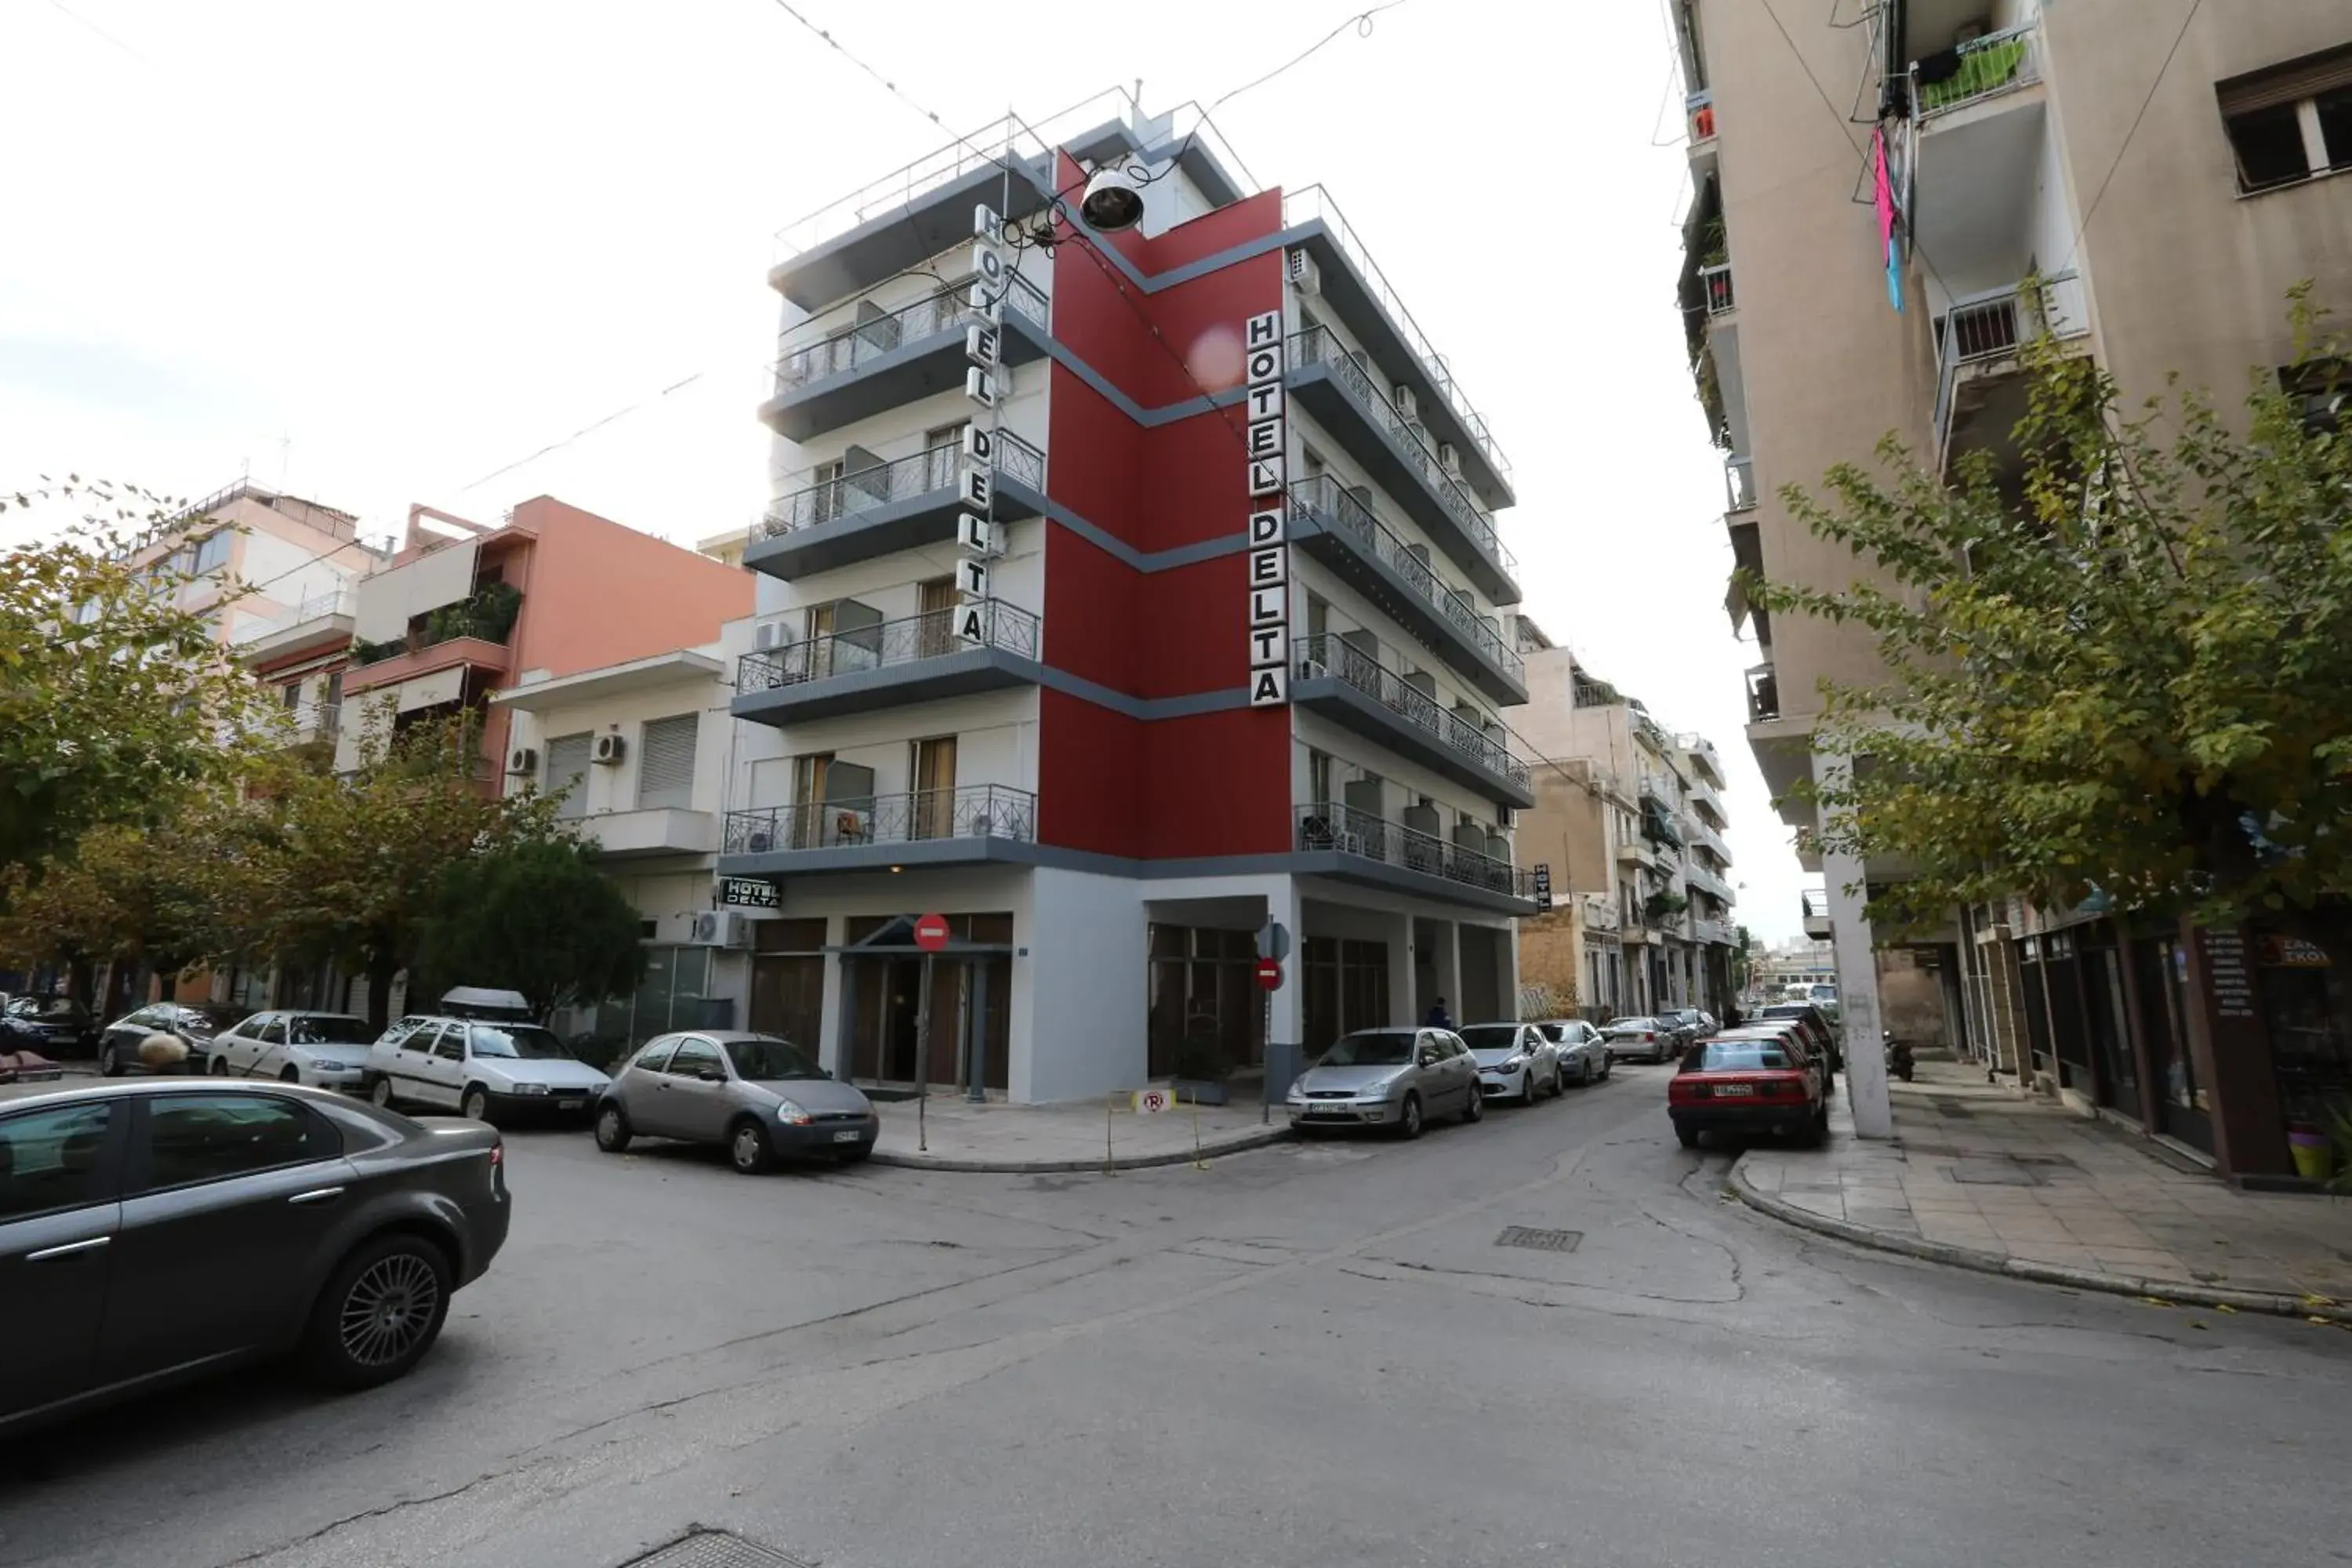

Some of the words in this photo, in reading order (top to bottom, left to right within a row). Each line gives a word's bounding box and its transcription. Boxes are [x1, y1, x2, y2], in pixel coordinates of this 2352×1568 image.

[978, 207, 1001, 403] HOTEL
[1250, 315, 1276, 491] HOTEL
[963, 427, 990, 641] DELTA
[1254, 514, 1279, 702] DELTA
[728, 881, 780, 897] HOTEL
[728, 895, 779, 906] DELTA
